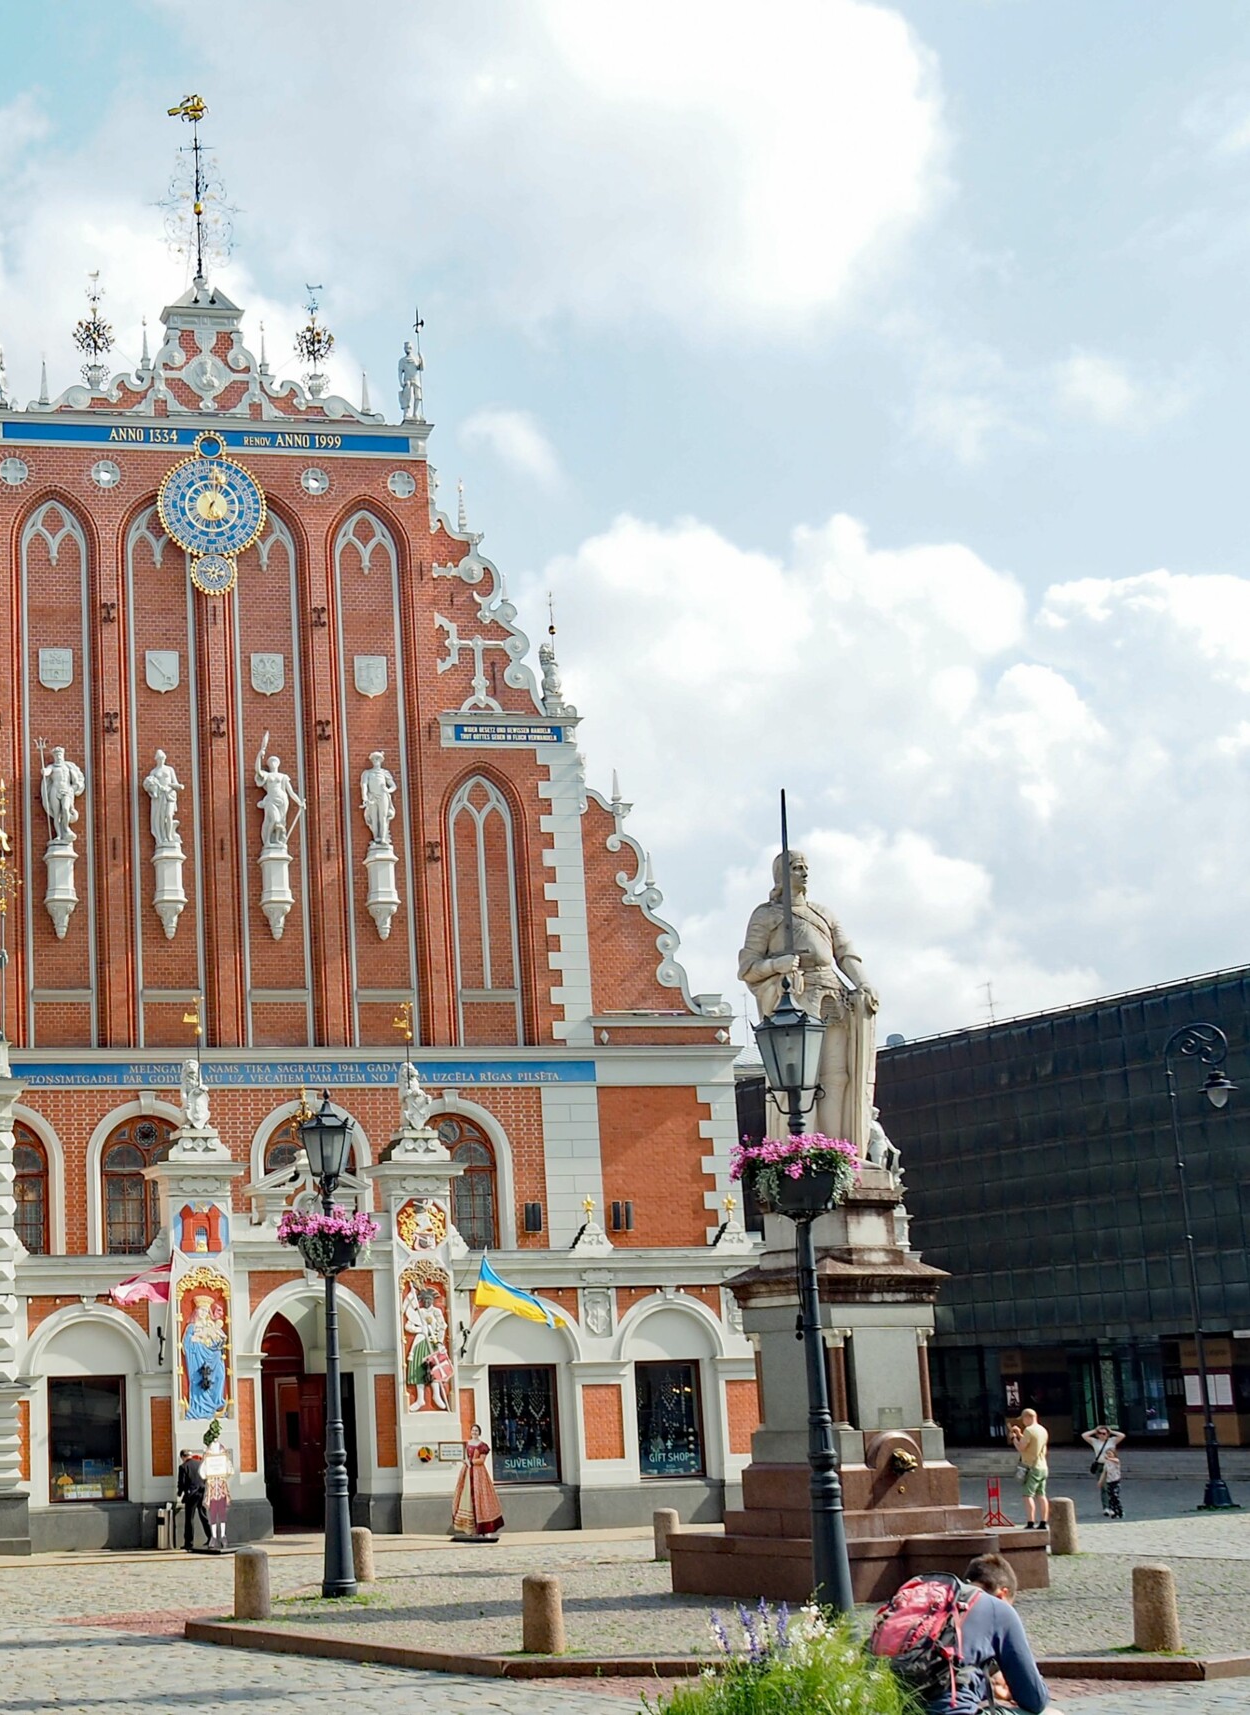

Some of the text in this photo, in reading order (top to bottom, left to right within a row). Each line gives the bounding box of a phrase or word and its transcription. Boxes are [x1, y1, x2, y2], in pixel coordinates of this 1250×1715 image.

[108, 427, 177, 443] ANNO 1334
[243, 433, 342, 449] RENOV. ANNO 1999
[208, 1064, 239, 1074] NAMS
[244, 1064, 271, 1073] TIKA
[277, 1064, 332, 1074] SAGRAUTS
[338, 1063, 362, 1073] 1941.
[123, 1075, 144, 1084] PAR
[229, 1074, 245, 1083] UZ
[249, 1074, 304, 1084] VECAJIEM
[309, 1073, 366, 1083] PAMATIEM
[371, 1073, 388, 1082] NO
[480, 1071, 513, 1082] RĪGAS
[649, 1451, 690, 1463] GIFT SHOP
